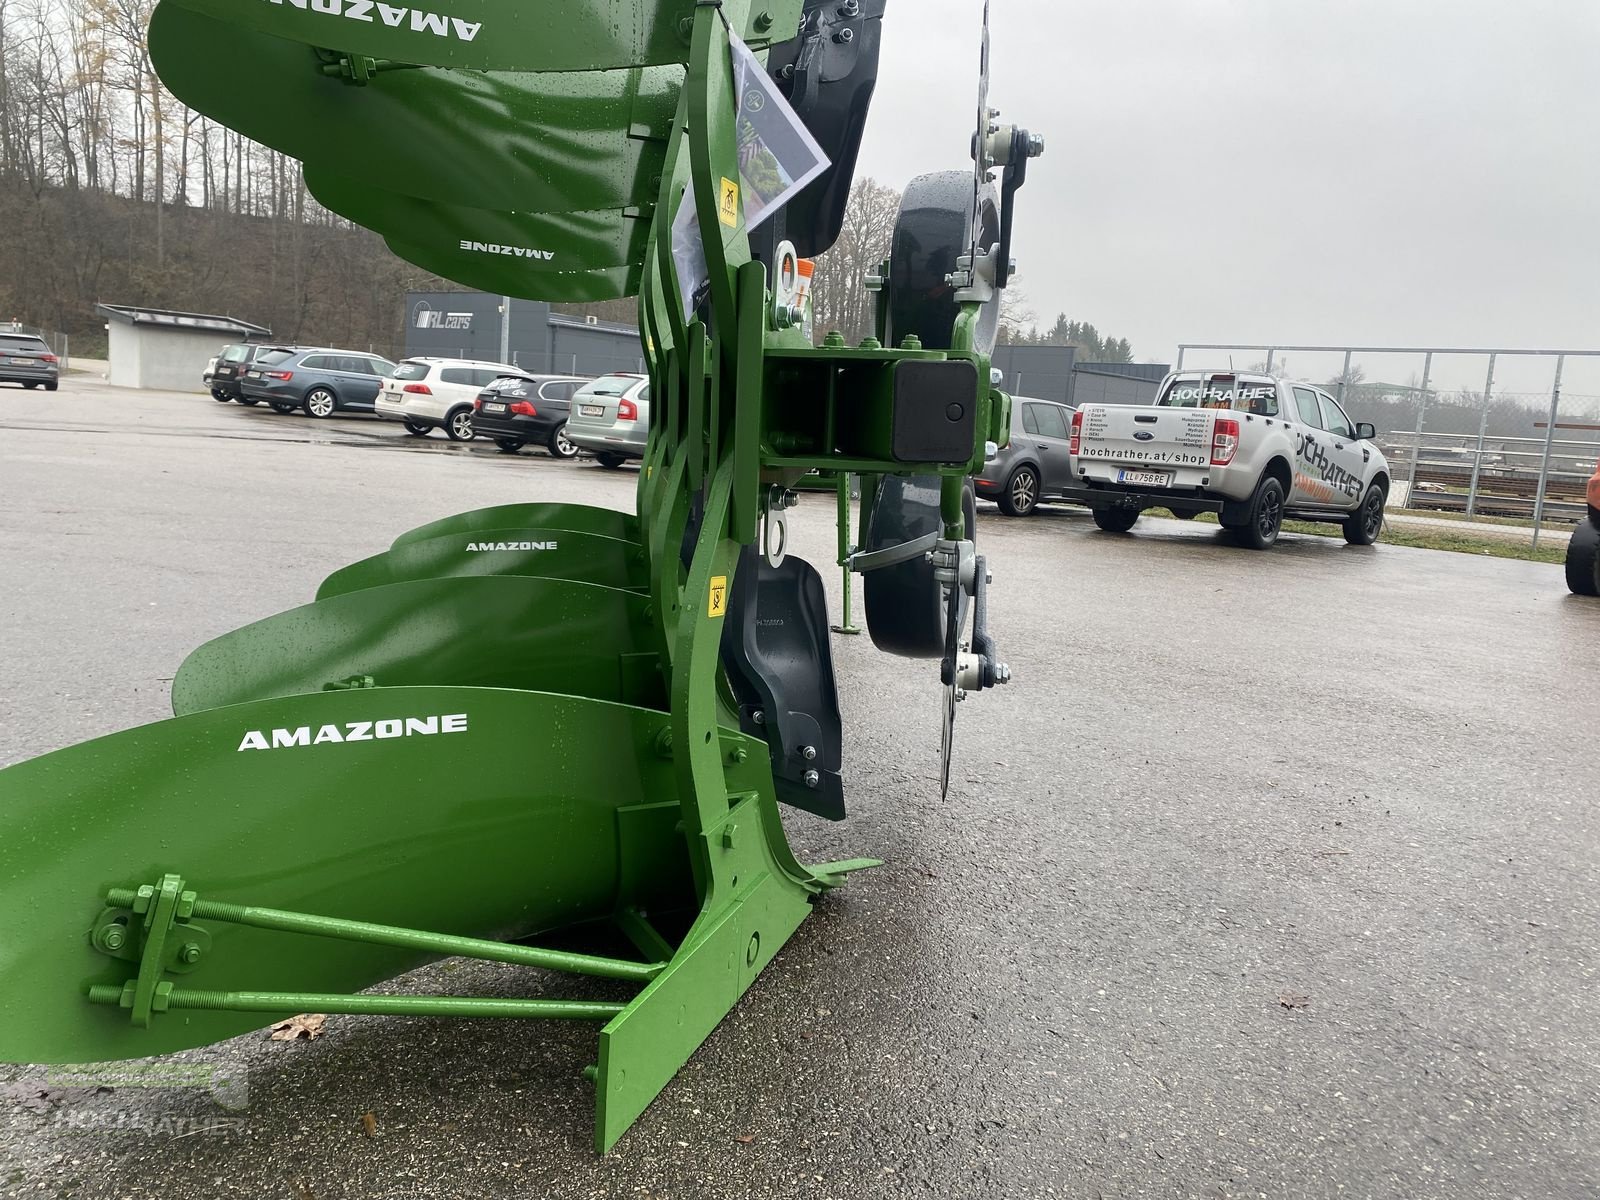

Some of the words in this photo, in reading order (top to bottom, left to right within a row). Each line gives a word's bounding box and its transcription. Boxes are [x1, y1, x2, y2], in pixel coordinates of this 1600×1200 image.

[264, 0, 482, 42] AMAZO
[460, 240, 555, 260] AMAZONE
[1168, 386, 1275, 401] HOCHRATHER
[1083, 447, 1206, 465] hochrather.at/shop
[465, 541, 558, 552] AMAZONE
[237, 713, 468, 752] AMAZONE
